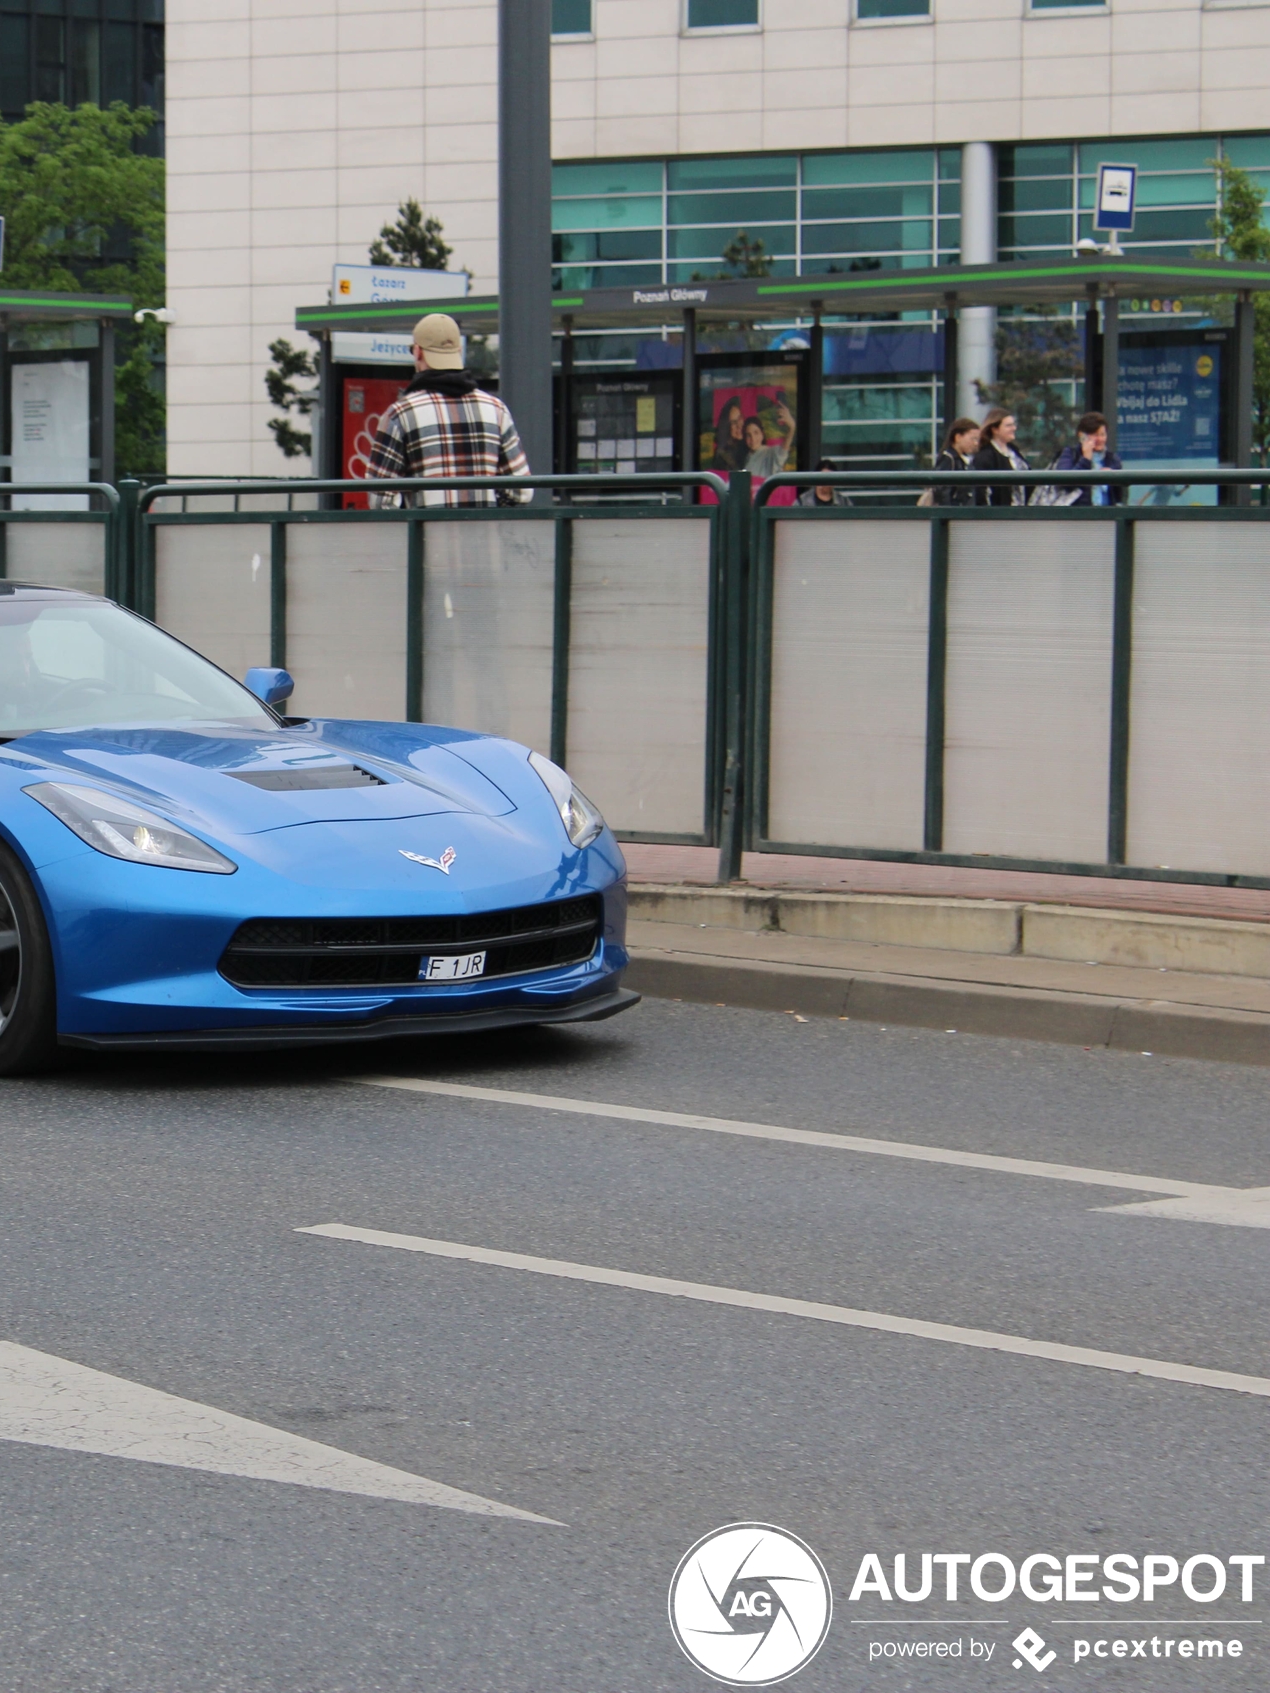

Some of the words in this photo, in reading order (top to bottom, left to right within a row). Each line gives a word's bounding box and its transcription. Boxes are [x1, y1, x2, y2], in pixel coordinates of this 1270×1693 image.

[633, 289, 670, 304] Poznań
[670, 288, 708, 302] Główny
[429, 959, 444, 977] F
